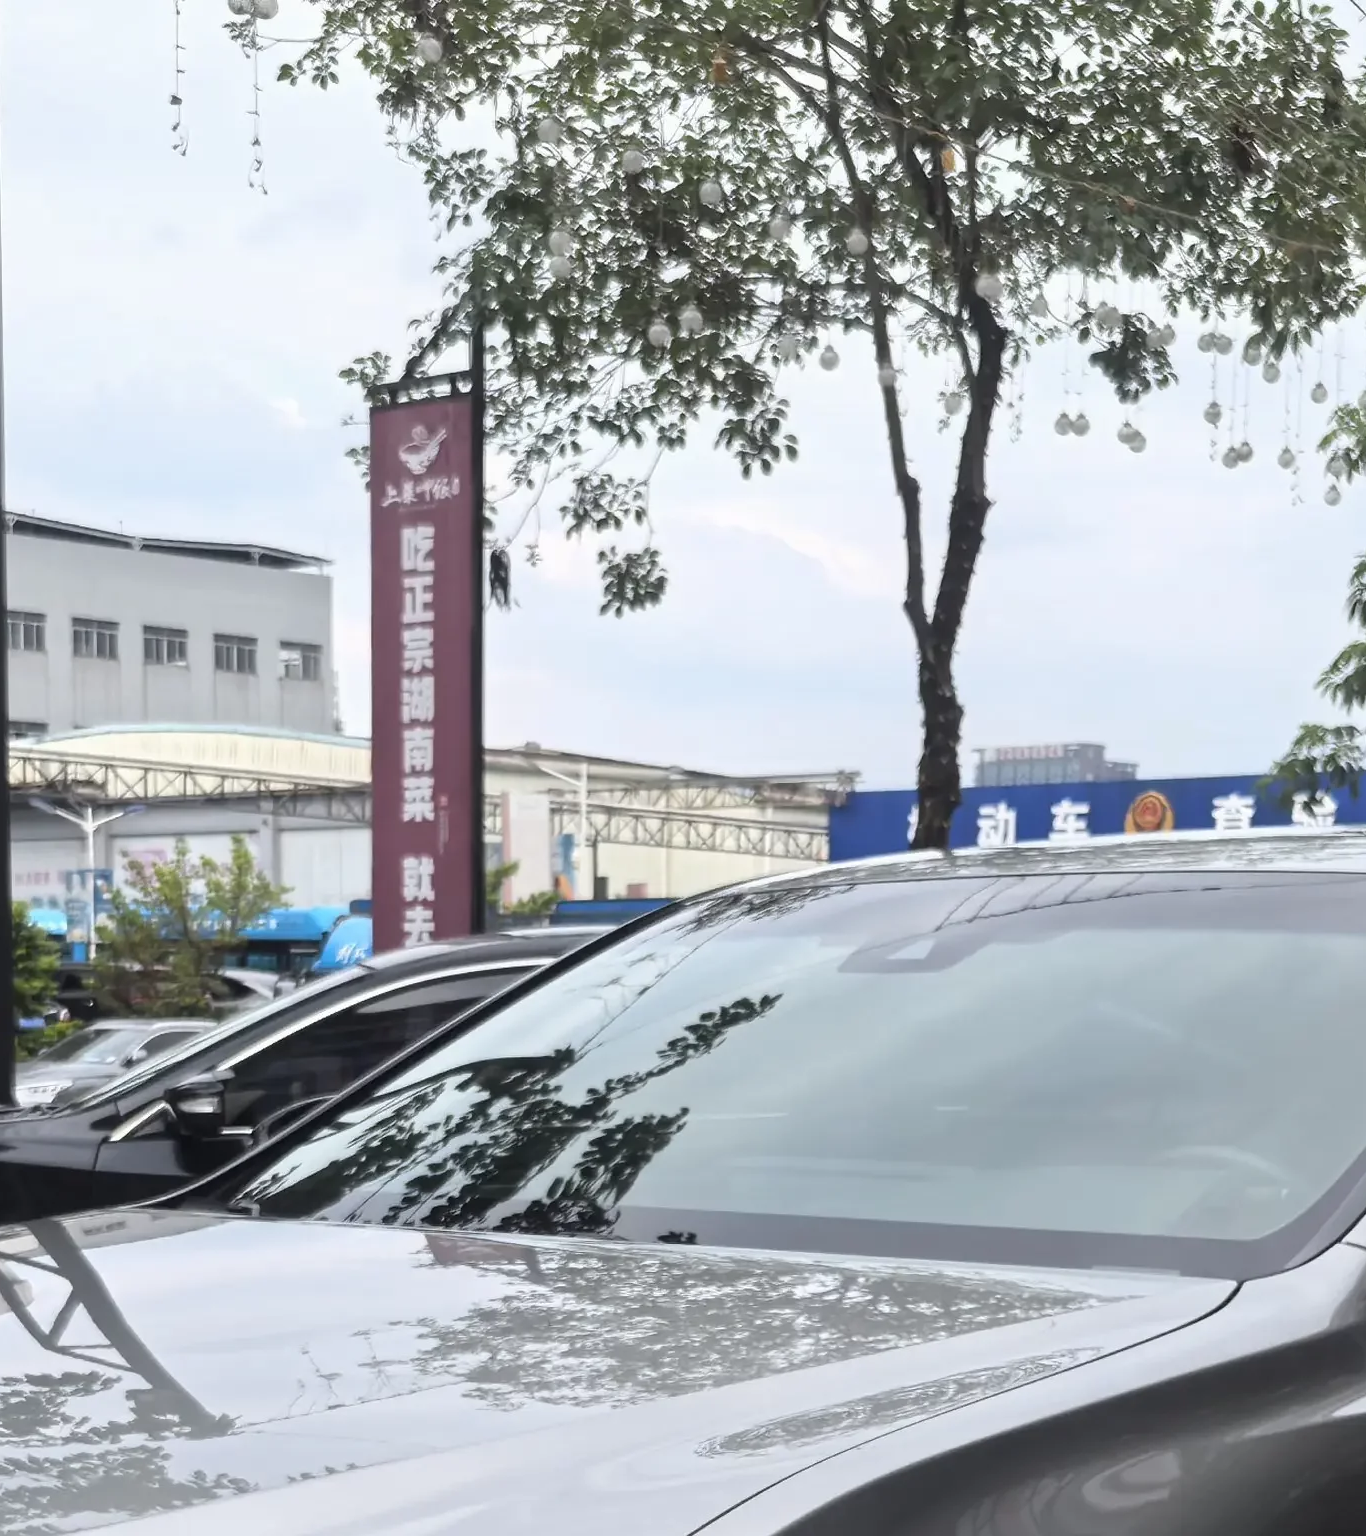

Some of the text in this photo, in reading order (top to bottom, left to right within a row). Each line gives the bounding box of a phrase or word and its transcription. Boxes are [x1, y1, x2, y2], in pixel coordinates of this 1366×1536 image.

[400, 524, 435, 823] 吃正宗湖南菜
[907, 797, 1092, 848] 动车
[401, 856, 436, 948] 就去
